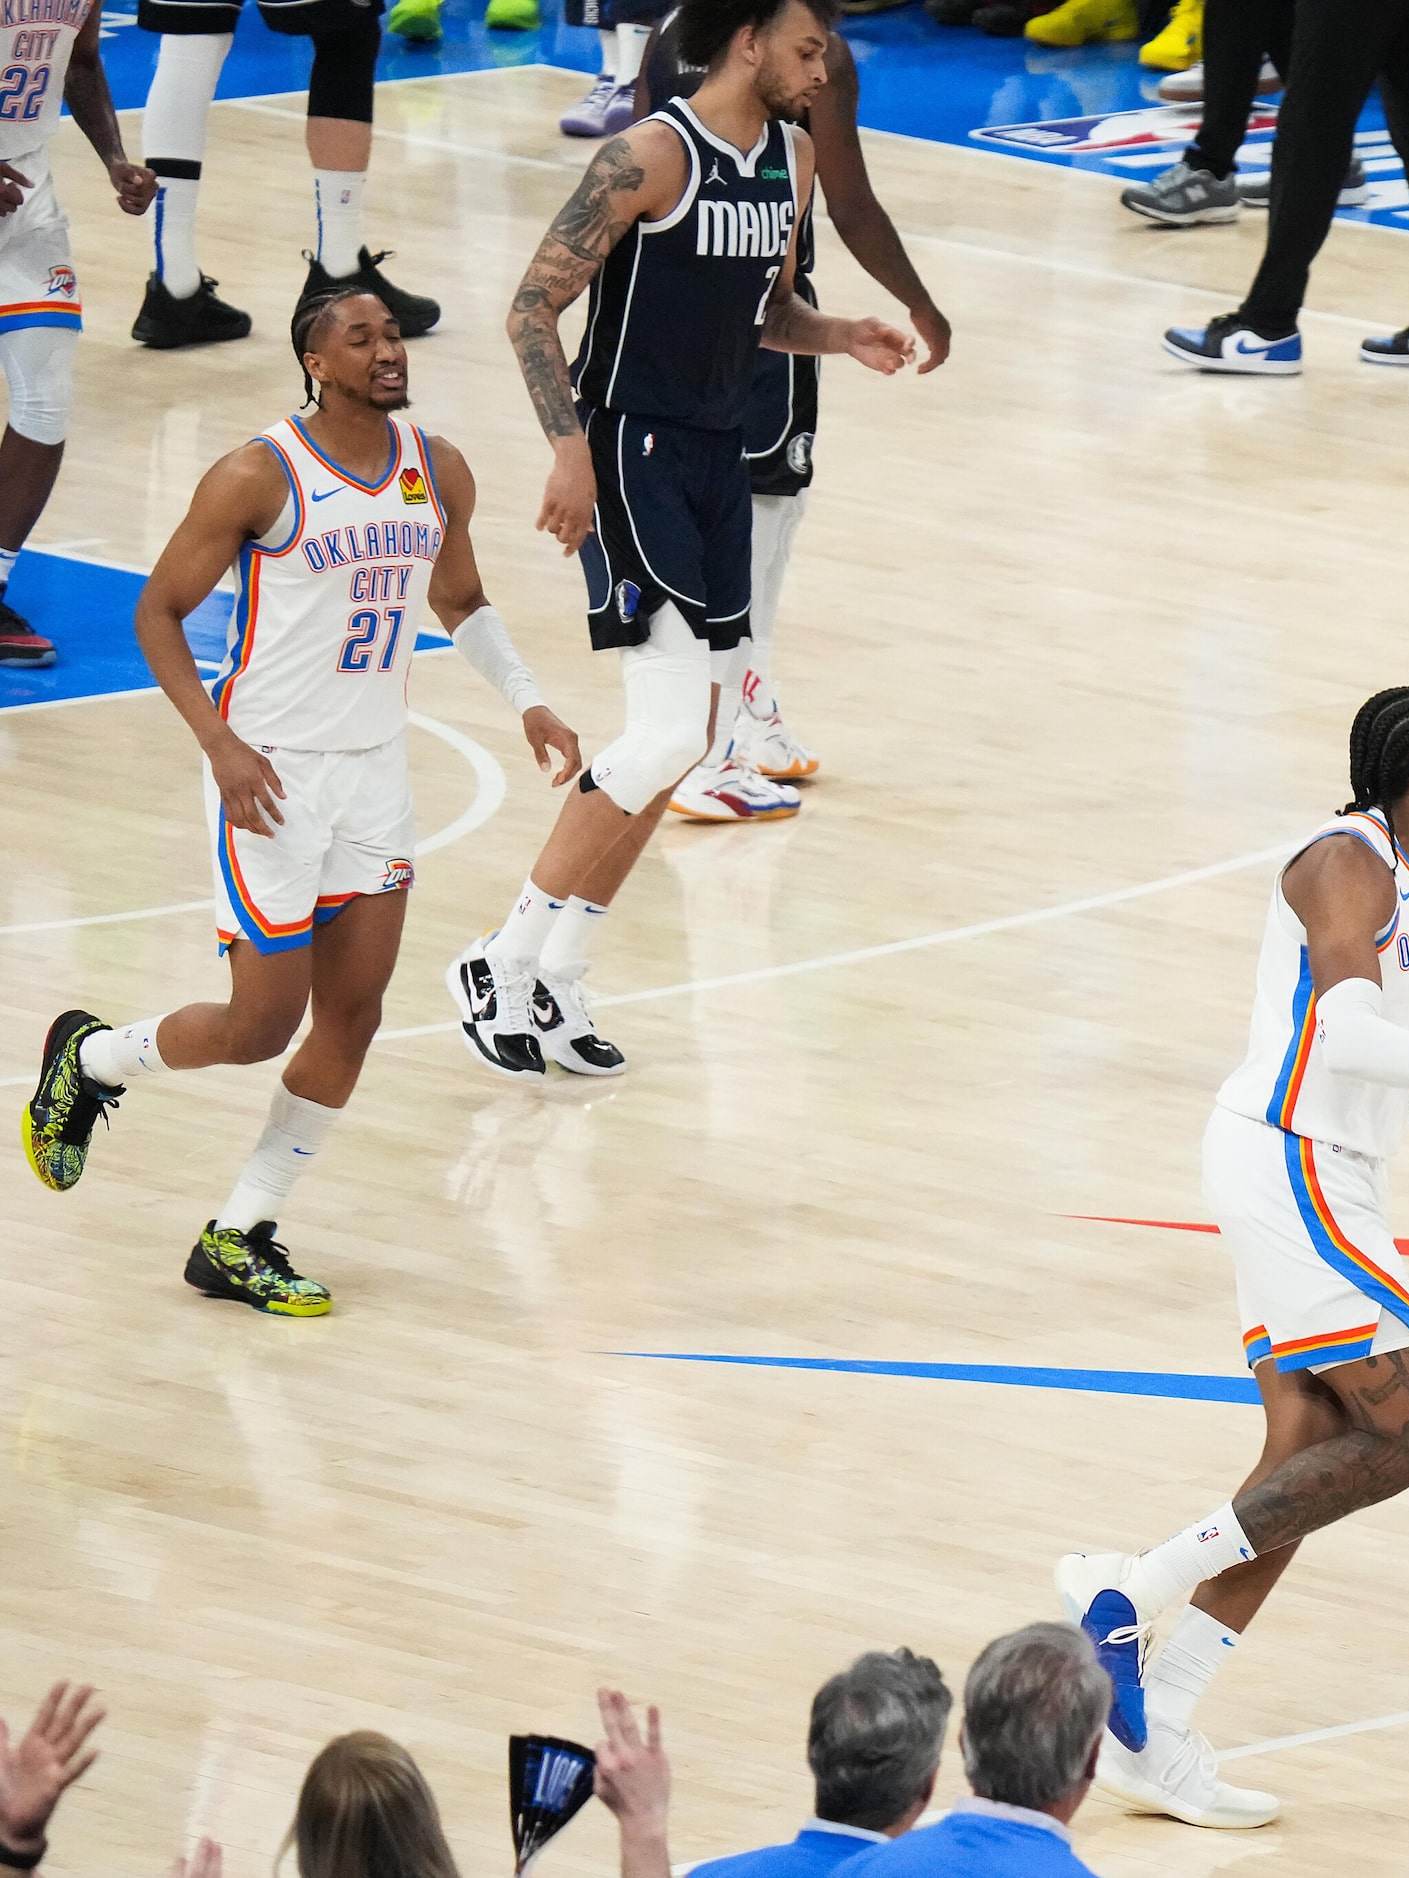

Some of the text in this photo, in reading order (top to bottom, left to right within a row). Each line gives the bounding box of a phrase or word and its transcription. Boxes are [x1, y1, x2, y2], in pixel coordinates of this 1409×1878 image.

[0, 0, 90, 28] KLAHOMA
[11, 29, 61, 61] CITY
[0, 64, 50, 122] 22
[761, 166, 789, 180] chime
[696, 200, 794, 257] MAVS
[301, 521, 441, 573] OKLAHOMA
[350, 565, 413, 602] CITY
[336, 606, 405, 673] 21
